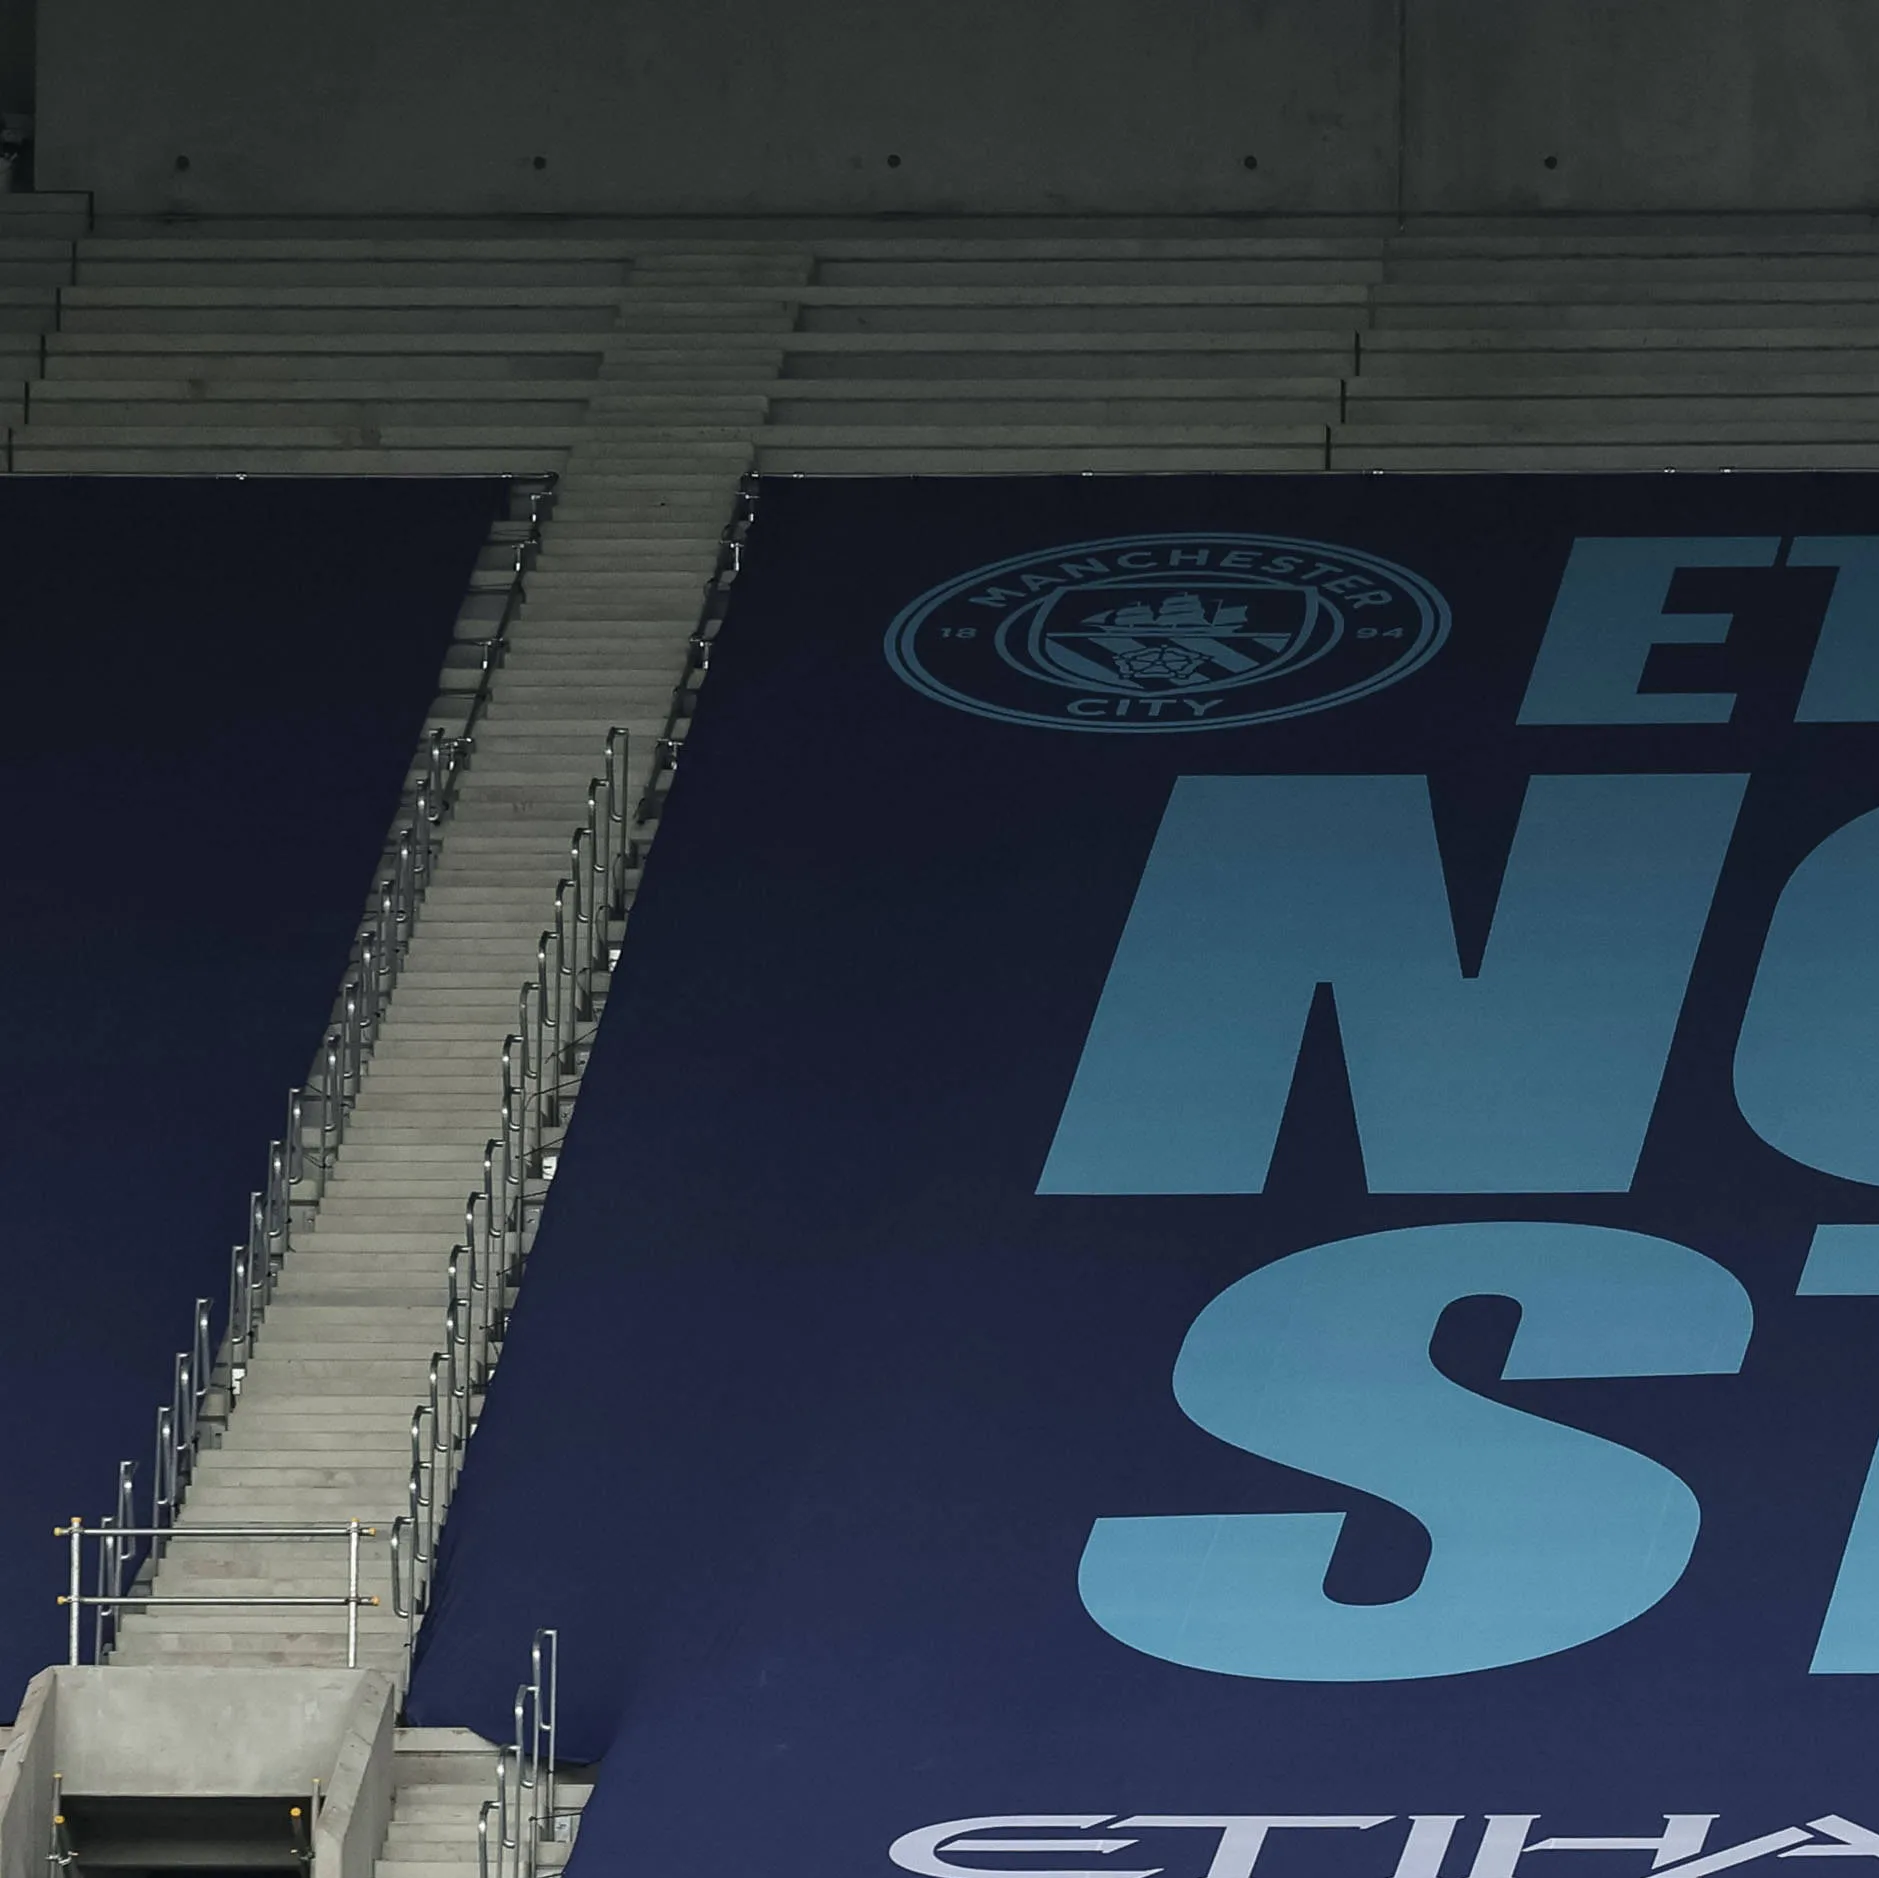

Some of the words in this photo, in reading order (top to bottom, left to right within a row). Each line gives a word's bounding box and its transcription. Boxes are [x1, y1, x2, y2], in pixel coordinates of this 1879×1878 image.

[967, 548, 1393, 609] MANCHESTER
[940, 626, 977, 640] 18
[1357, 626, 1404, 640] 94
[1066, 698, 1224, 717] CITY
